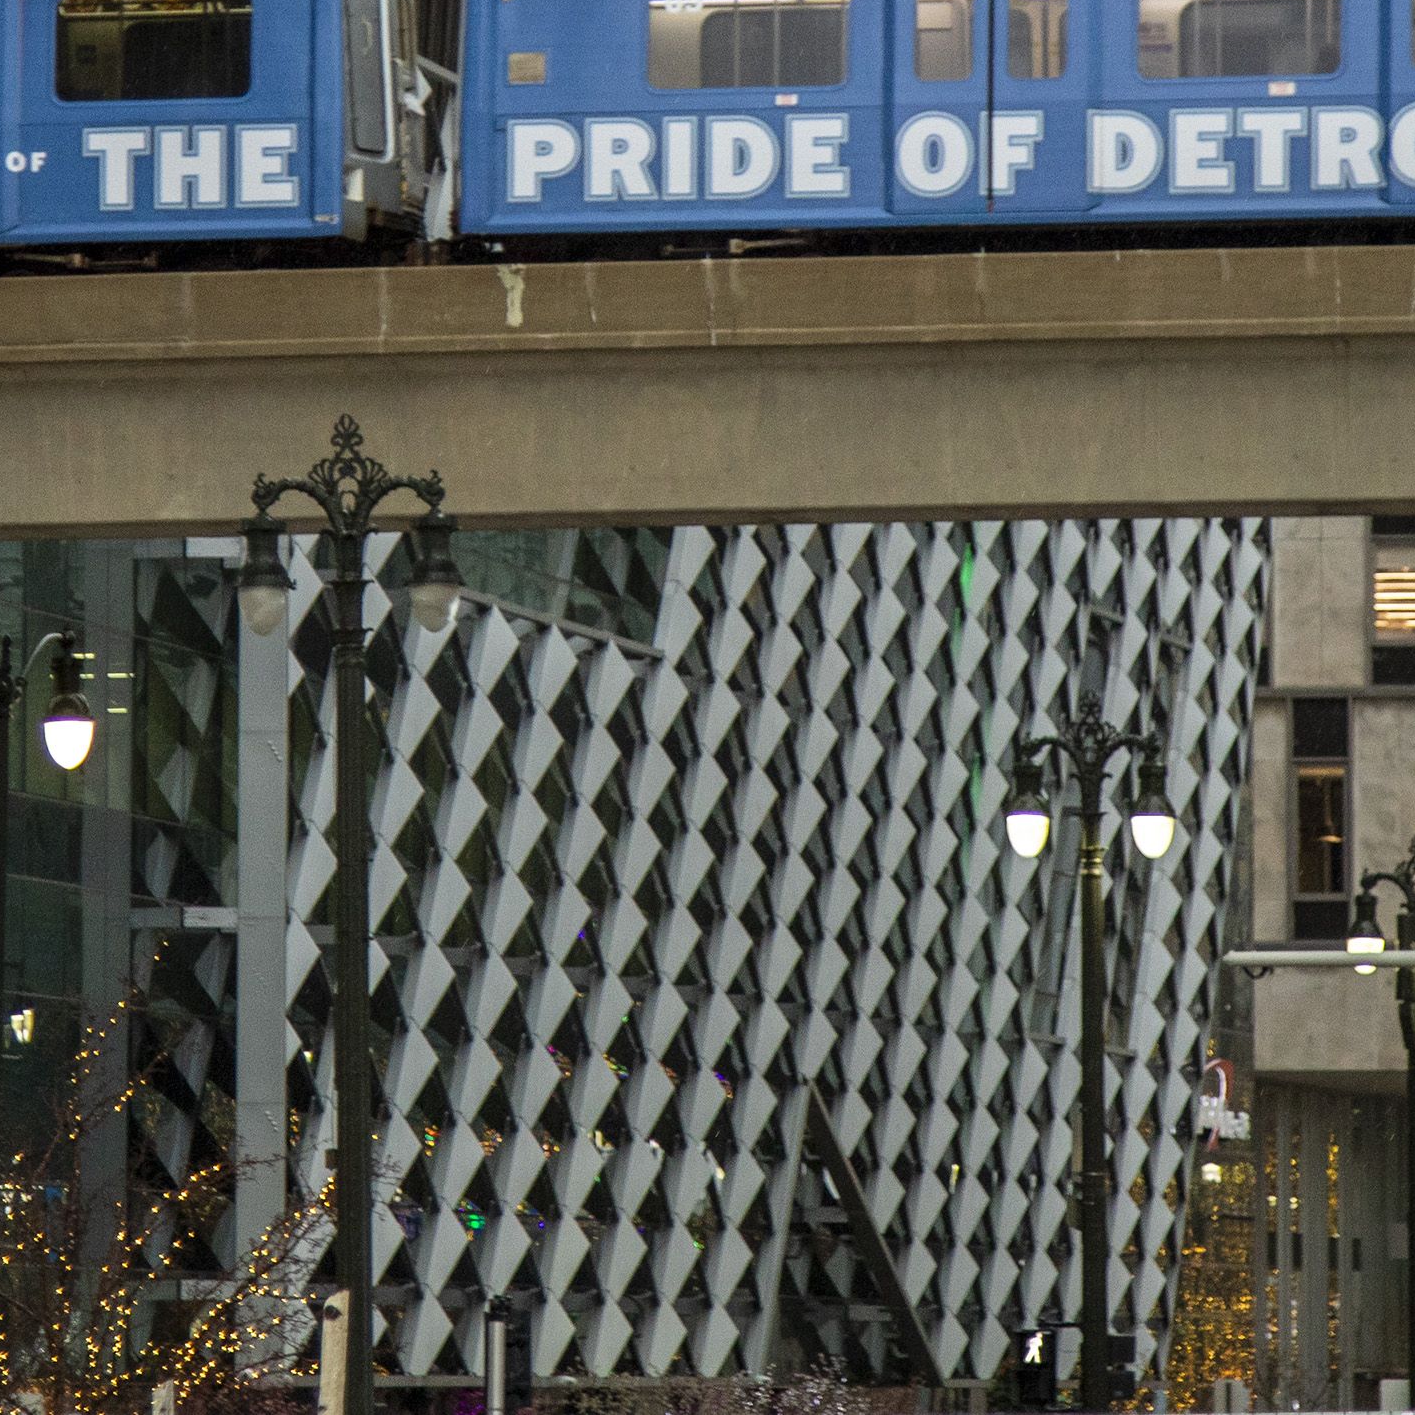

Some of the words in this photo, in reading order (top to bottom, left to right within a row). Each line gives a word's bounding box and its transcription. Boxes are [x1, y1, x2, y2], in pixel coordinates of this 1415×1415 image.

[5, 150, 47, 173] OF
[82, 123, 302, 212] THE
[505, 111, 851, 203] PRIDE
[896, 109, 1045, 198] OF
